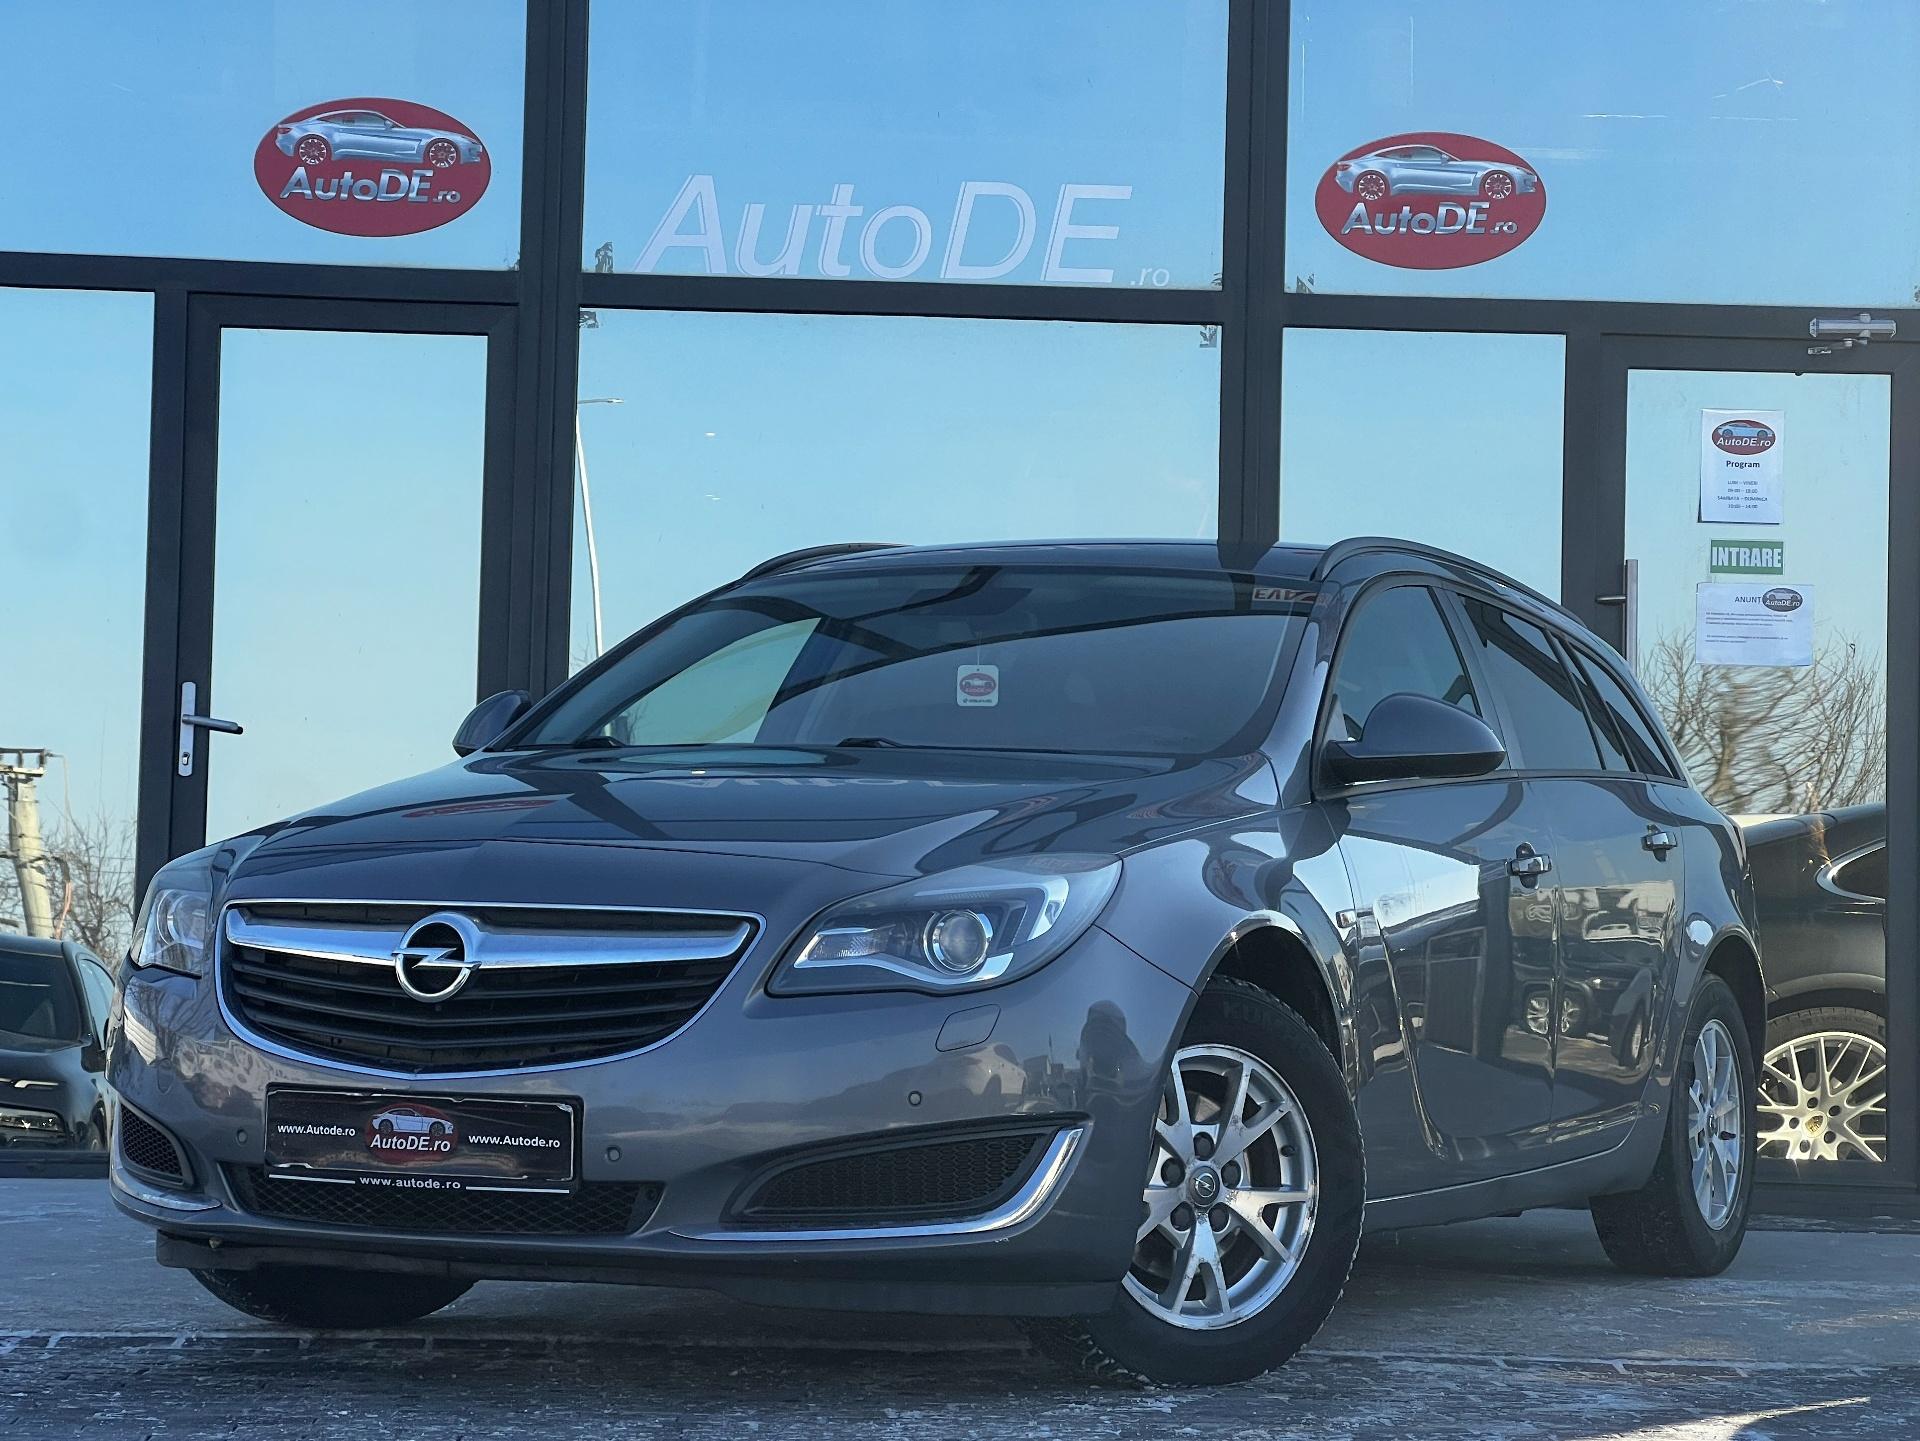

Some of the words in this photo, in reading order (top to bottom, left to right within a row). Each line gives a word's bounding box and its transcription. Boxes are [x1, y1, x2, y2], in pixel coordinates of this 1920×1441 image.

[1716, 437, 1771, 447] AutoDE.ro
[1726, 460, 1760, 469] Program
[1712, 547, 1782, 570] INTRARE
[277, 1124, 356, 1137] www.Autode.ro
[370, 1133, 451, 1152] AutoDE.ro
[468, 1133, 561, 1149] www.Autode.ro
[359, 1176, 461, 1190] www.autode.ro
